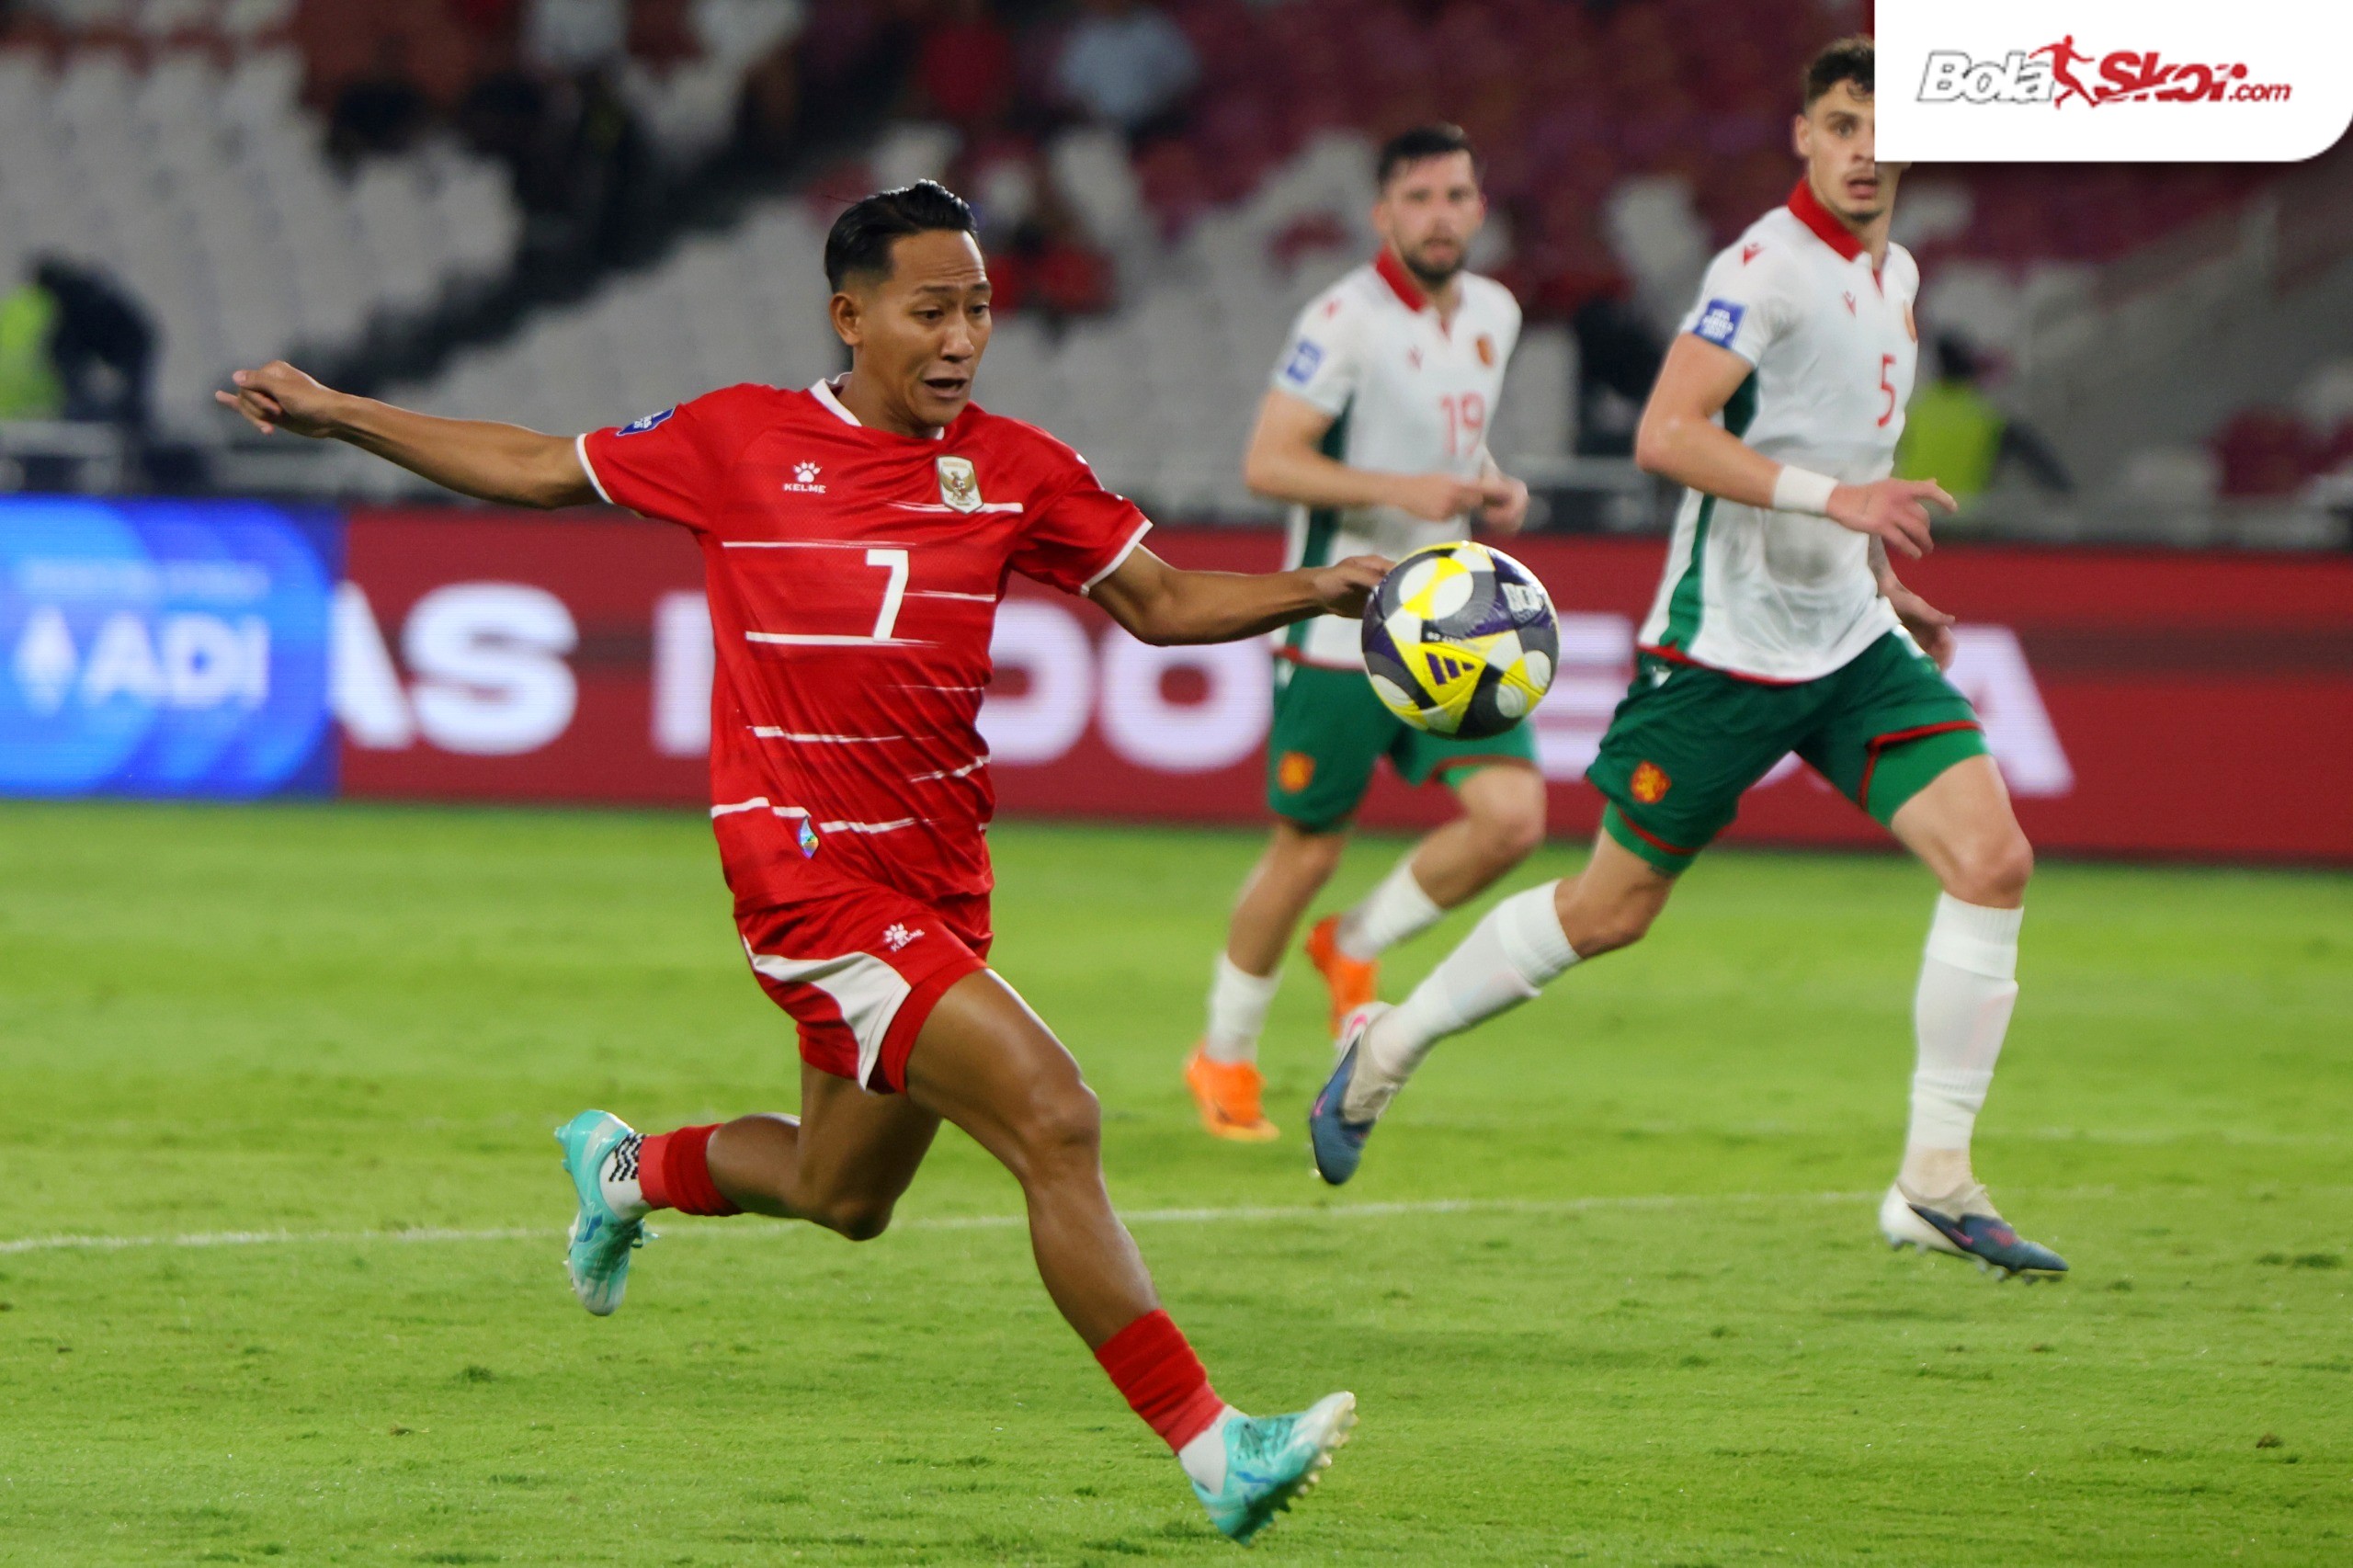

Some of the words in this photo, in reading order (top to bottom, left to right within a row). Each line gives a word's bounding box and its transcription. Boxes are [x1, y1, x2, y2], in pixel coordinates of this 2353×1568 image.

[1440, 392, 1486, 455] 19
[1876, 353, 1897, 427] 5
[783, 483, 827, 494] KELME
[866, 549, 909, 642] 7
